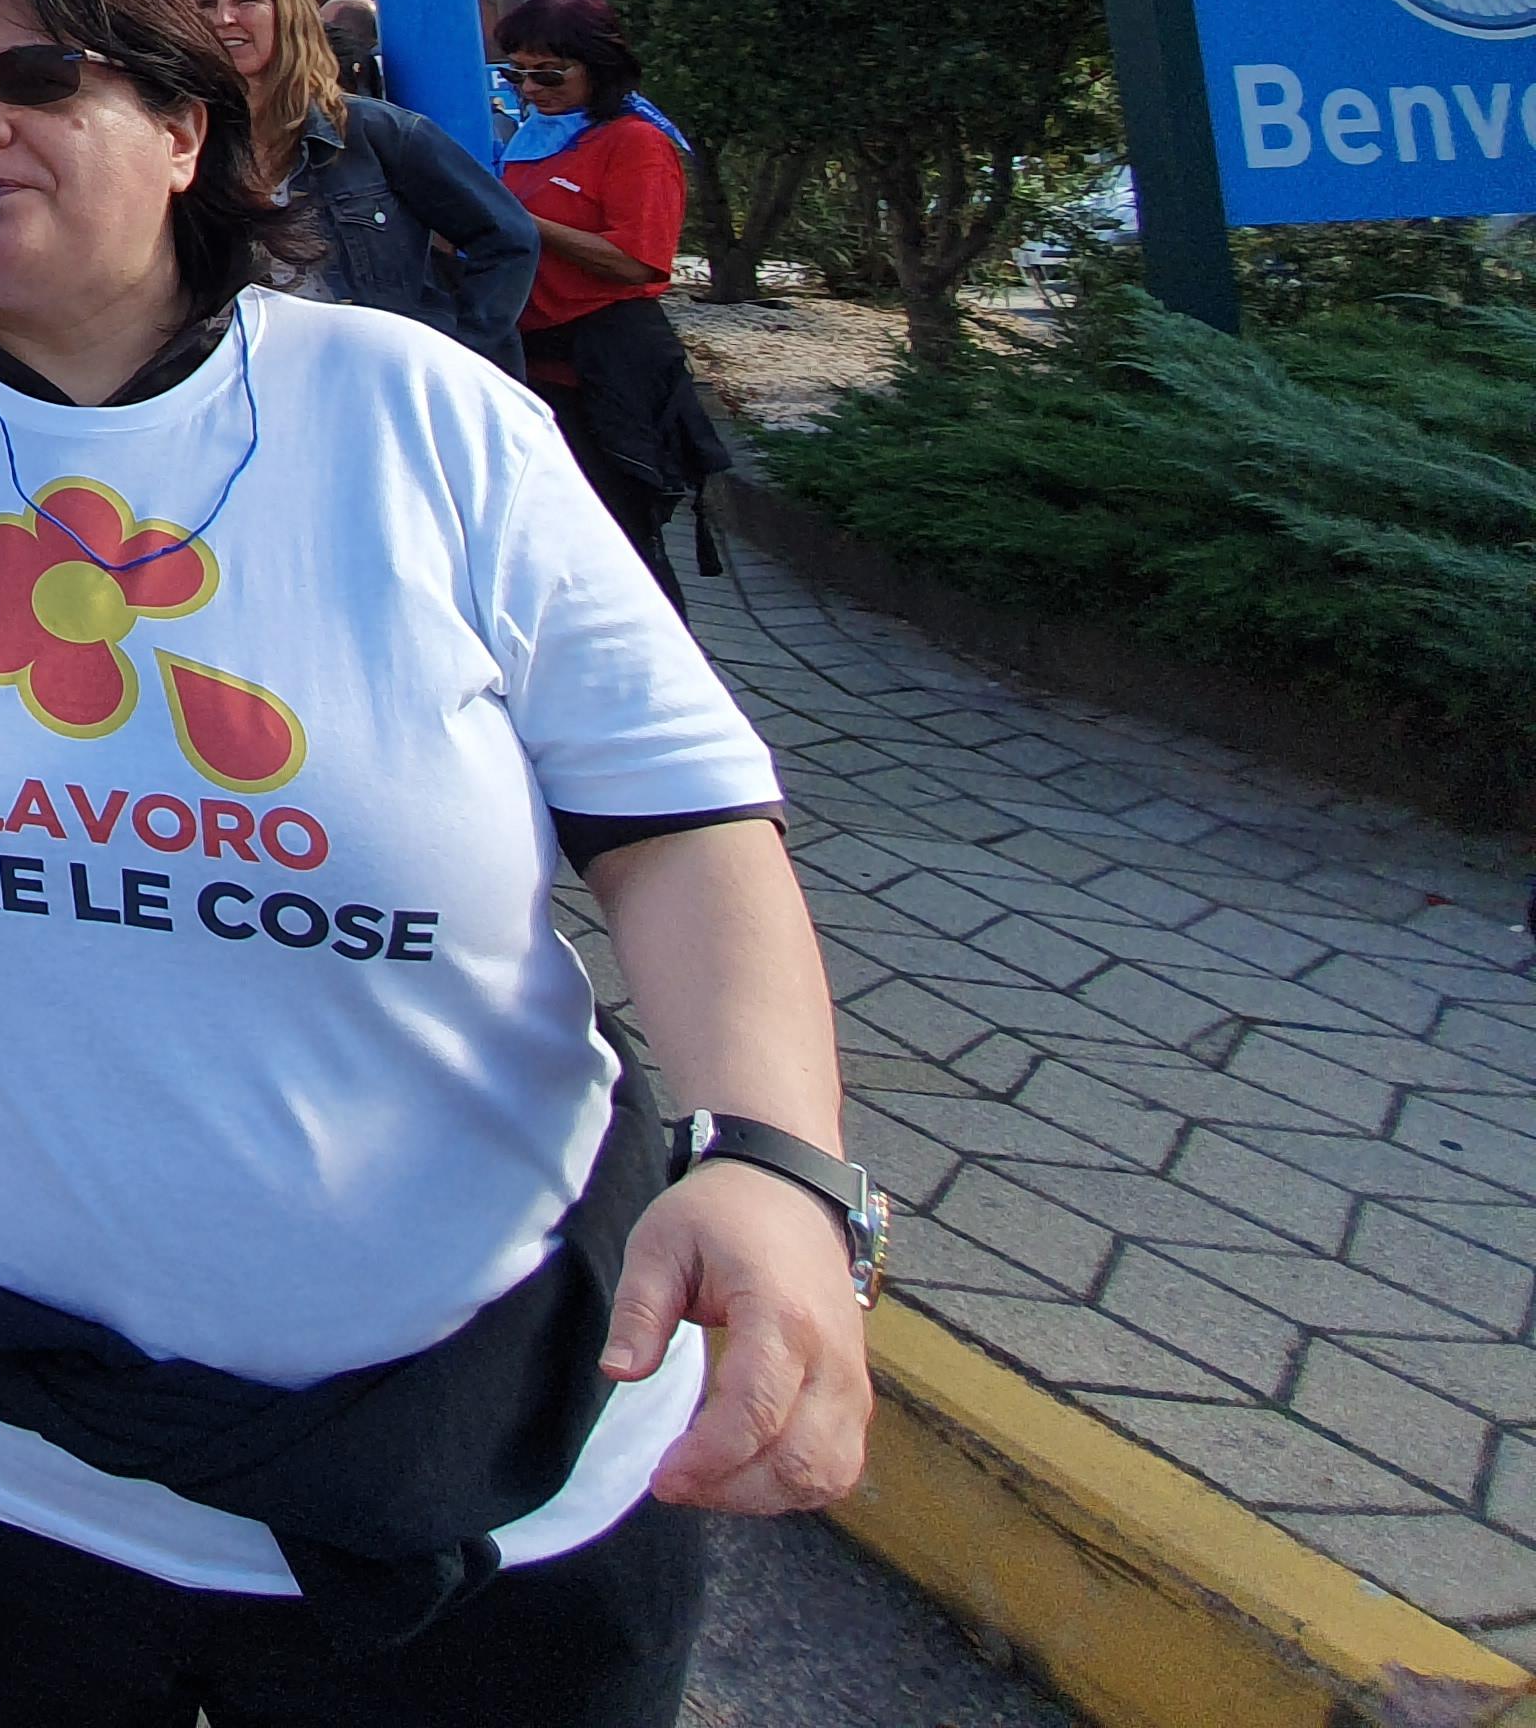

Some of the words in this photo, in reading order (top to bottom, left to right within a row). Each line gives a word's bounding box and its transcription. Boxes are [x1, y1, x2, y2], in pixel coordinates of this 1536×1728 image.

[1233, 62, 1536, 169] Benv
[69, 861, 174, 933] LE
[196, 881, 440, 963] COSE
